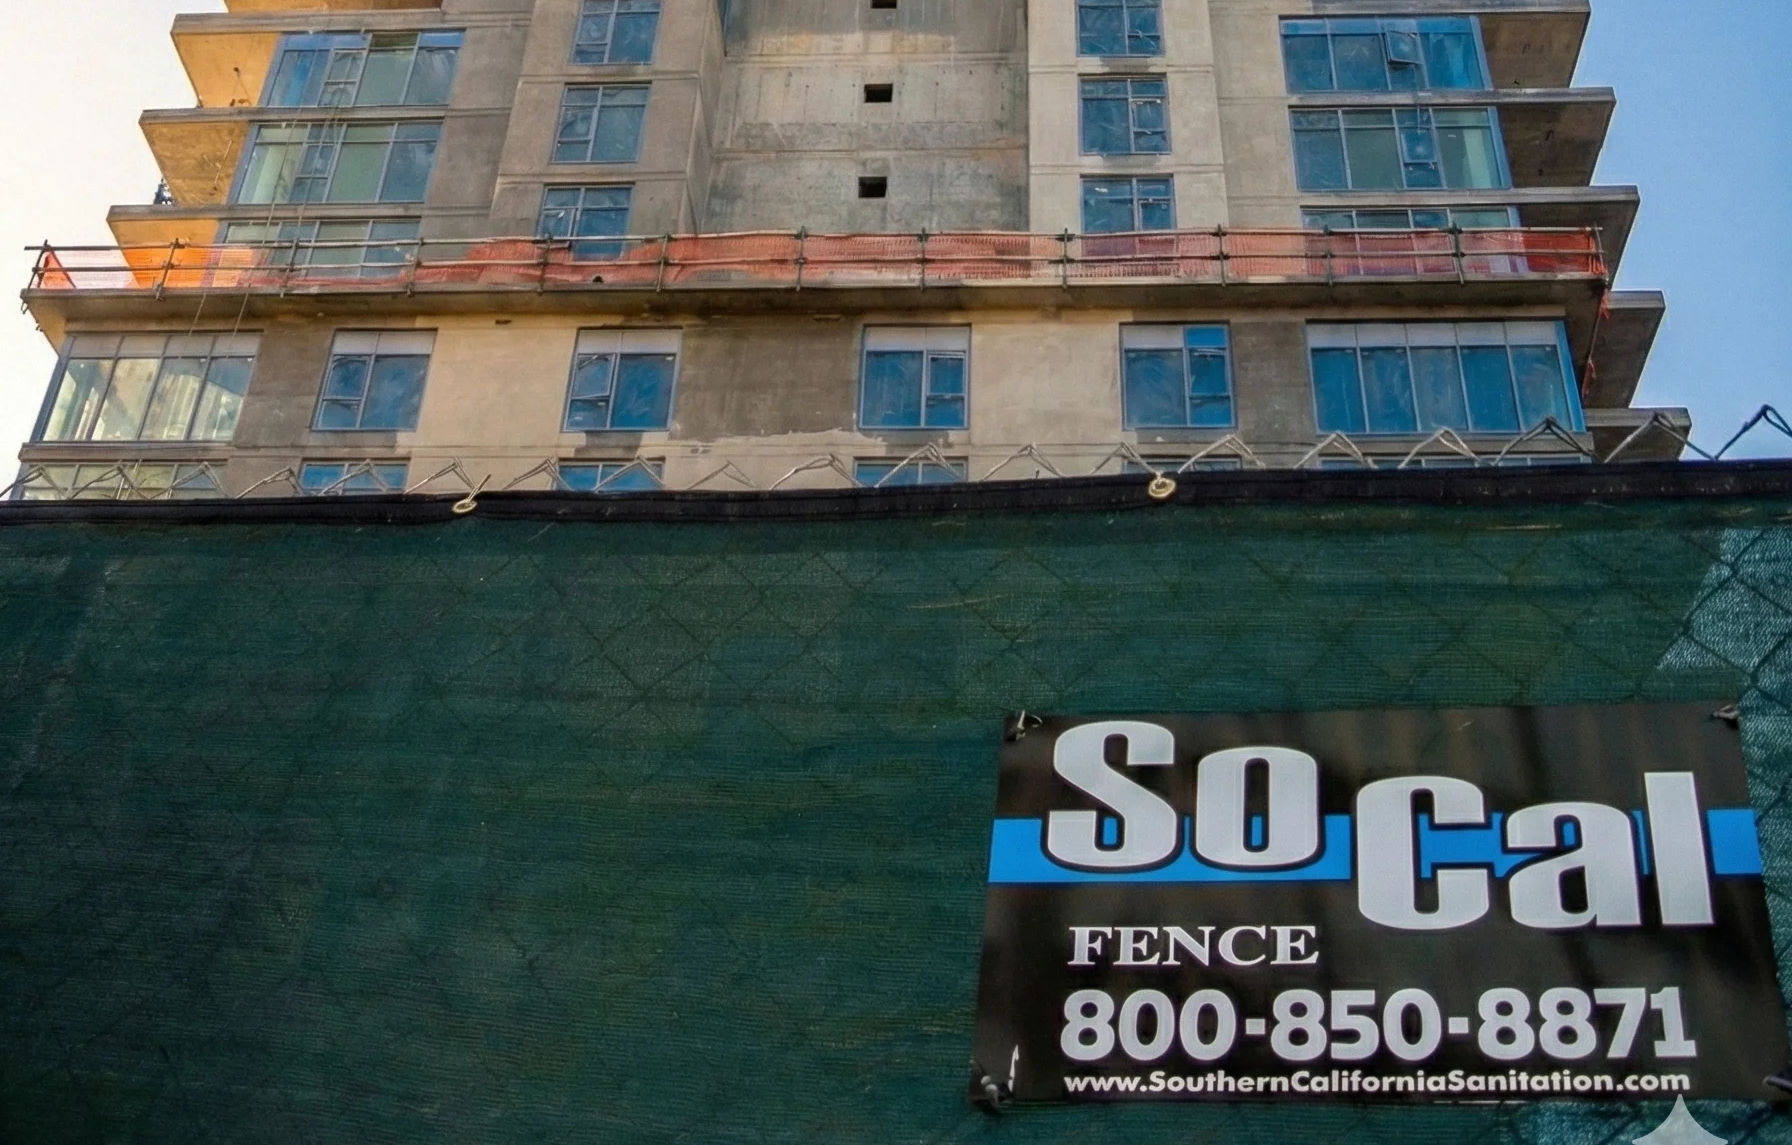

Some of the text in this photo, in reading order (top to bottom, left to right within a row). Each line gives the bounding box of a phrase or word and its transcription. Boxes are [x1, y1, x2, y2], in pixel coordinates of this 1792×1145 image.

[1066, 924, 1320, 967] FENCE
[1059, 985, 1698, 1062] 800-850-8871
[1063, 1068, 1692, 1093] www.SouthernCaliforniaSanitation.com
